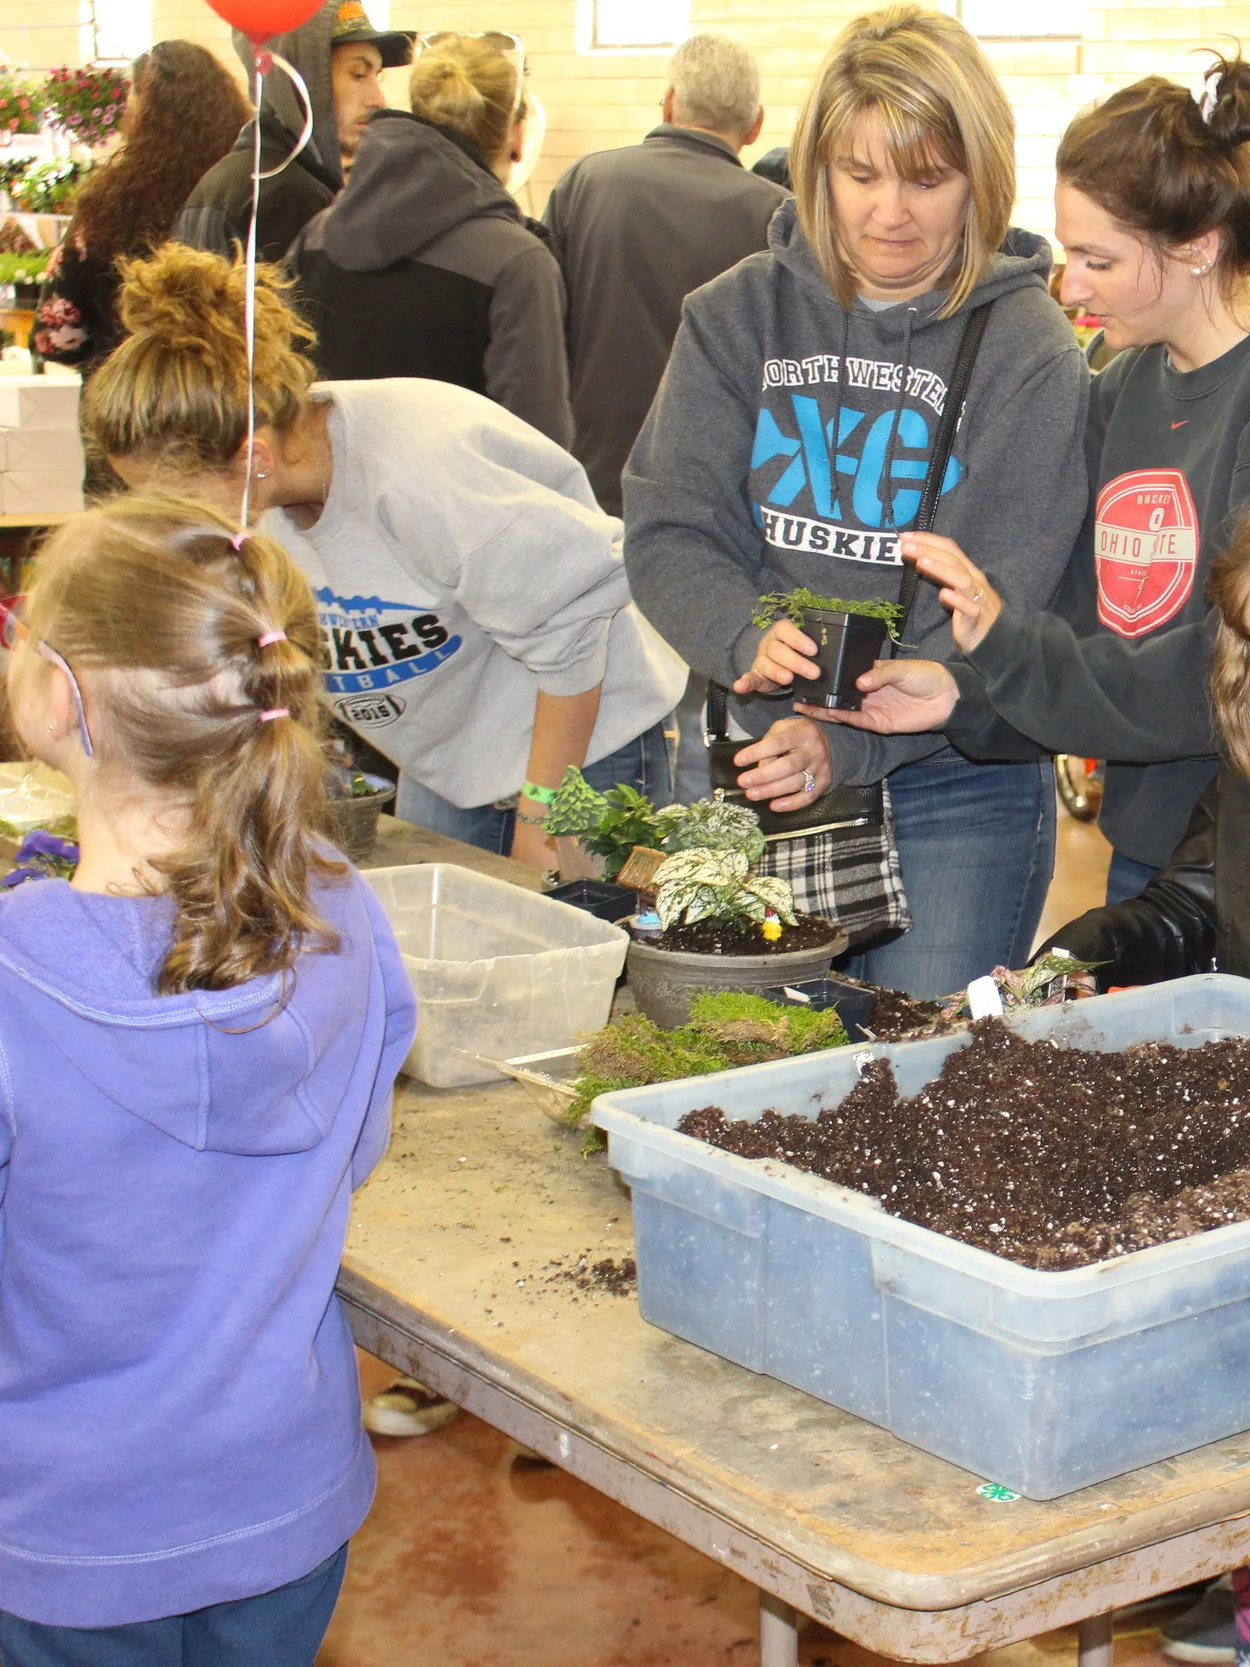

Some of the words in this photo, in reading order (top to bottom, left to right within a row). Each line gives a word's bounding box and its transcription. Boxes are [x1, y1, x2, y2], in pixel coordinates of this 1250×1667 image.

[761, 511, 900, 563] HUSKIE
[1101, 530, 1141, 558] OHIO
[320, 614, 449, 670] KIES
[332, 651, 451, 691] TBALL
[351, 705, 391, 721] 2015
